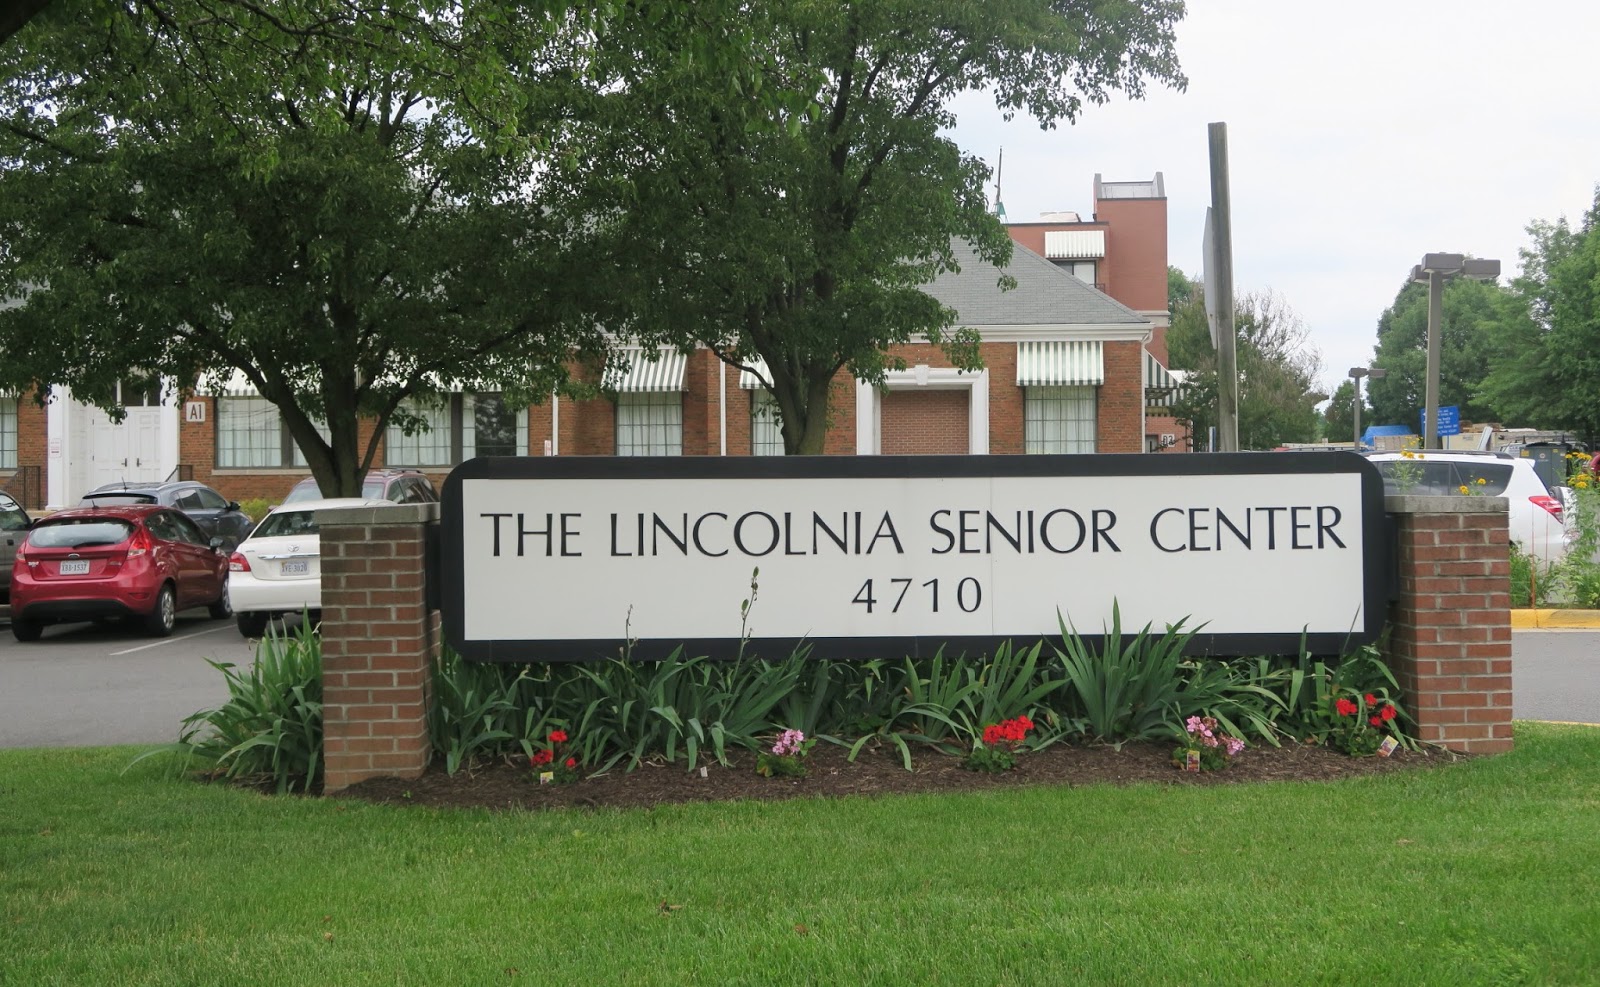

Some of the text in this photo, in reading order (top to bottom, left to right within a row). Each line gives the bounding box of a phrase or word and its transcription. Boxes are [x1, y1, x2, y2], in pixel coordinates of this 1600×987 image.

[189, 404, 202, 420] A1
[480, 505, 1347, 557] THE LINCOLNIA SENIOR CENTER
[851, 577, 982, 614] 4710
